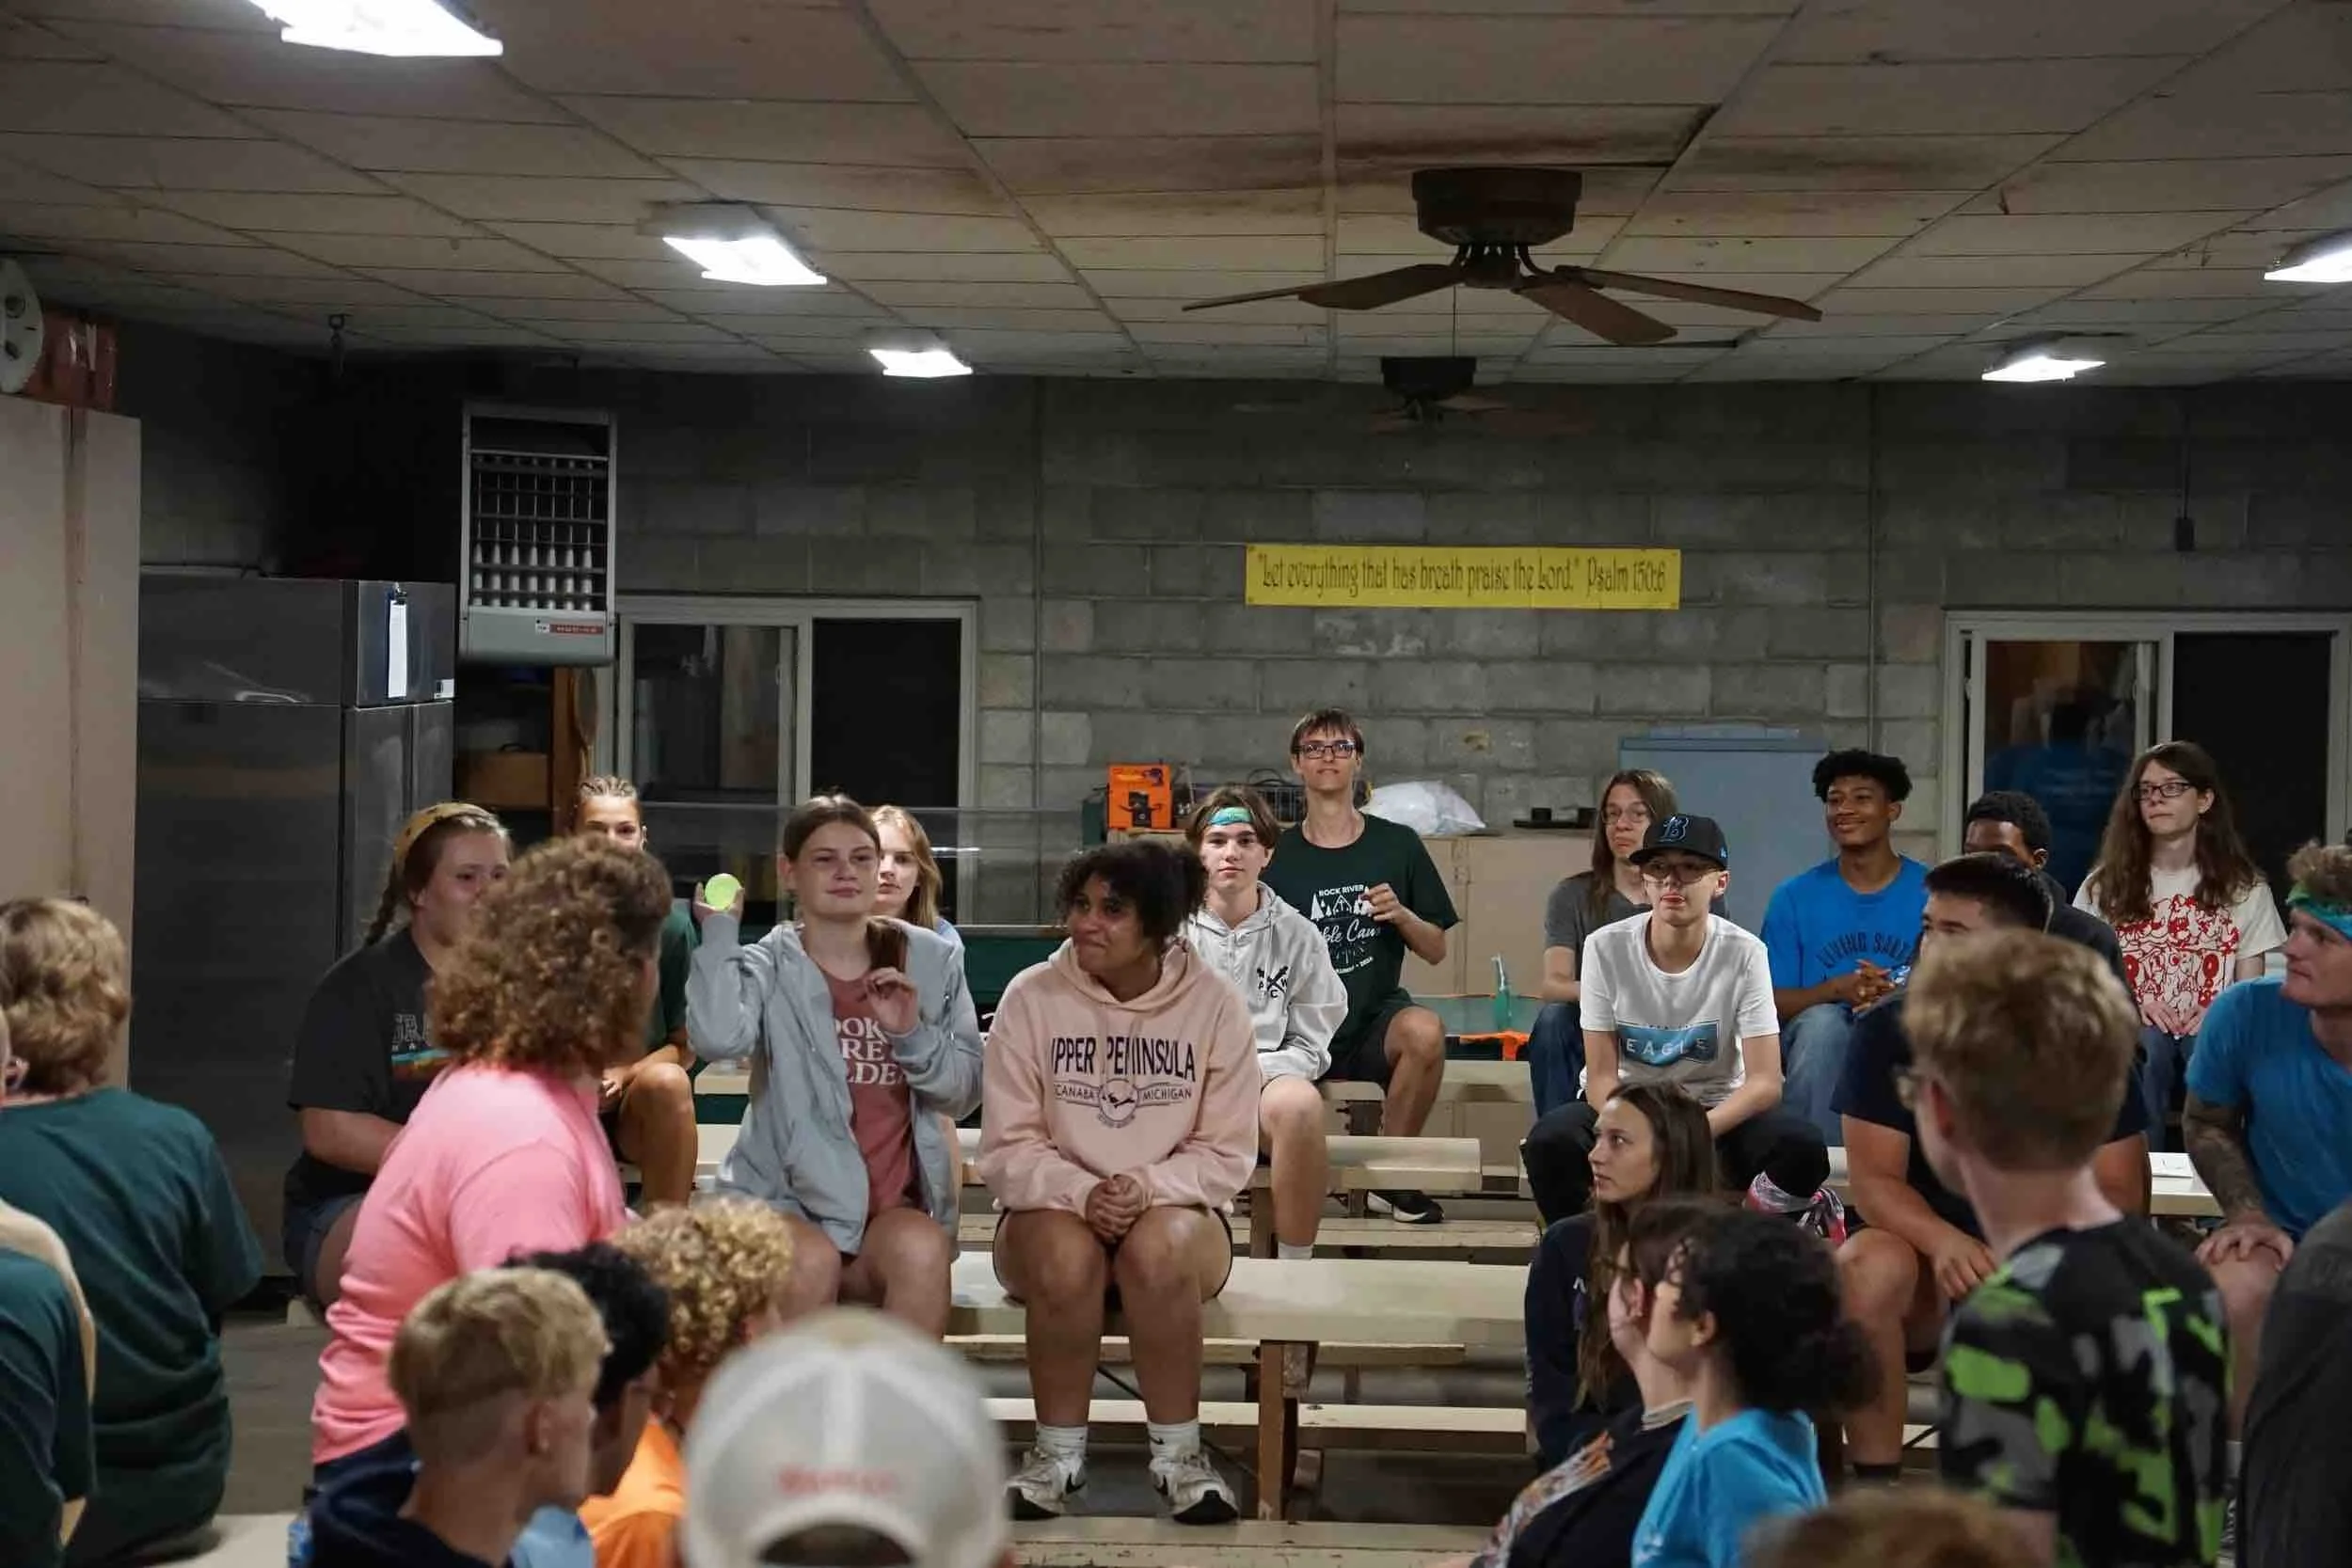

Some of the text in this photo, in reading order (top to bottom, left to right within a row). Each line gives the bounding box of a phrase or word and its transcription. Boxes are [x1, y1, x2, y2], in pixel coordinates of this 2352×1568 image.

[1287, 556, 1359, 598] everything
[1362, 556, 1388, 590] that
[1392, 556, 1416, 591] has
[1420, 556, 1463, 591] breath
[1467, 558, 1509, 598] praise
[1513, 557, 1534, 593] the
[1586, 555, 1629, 598] Psalm
[1632, 559, 1666, 594] 150:6
[1318, 884, 1364, 897] ROCK RIVER
[1323, 924, 1343, 943] ble
[1142, 1086, 1192, 1101] MICHIGAN
